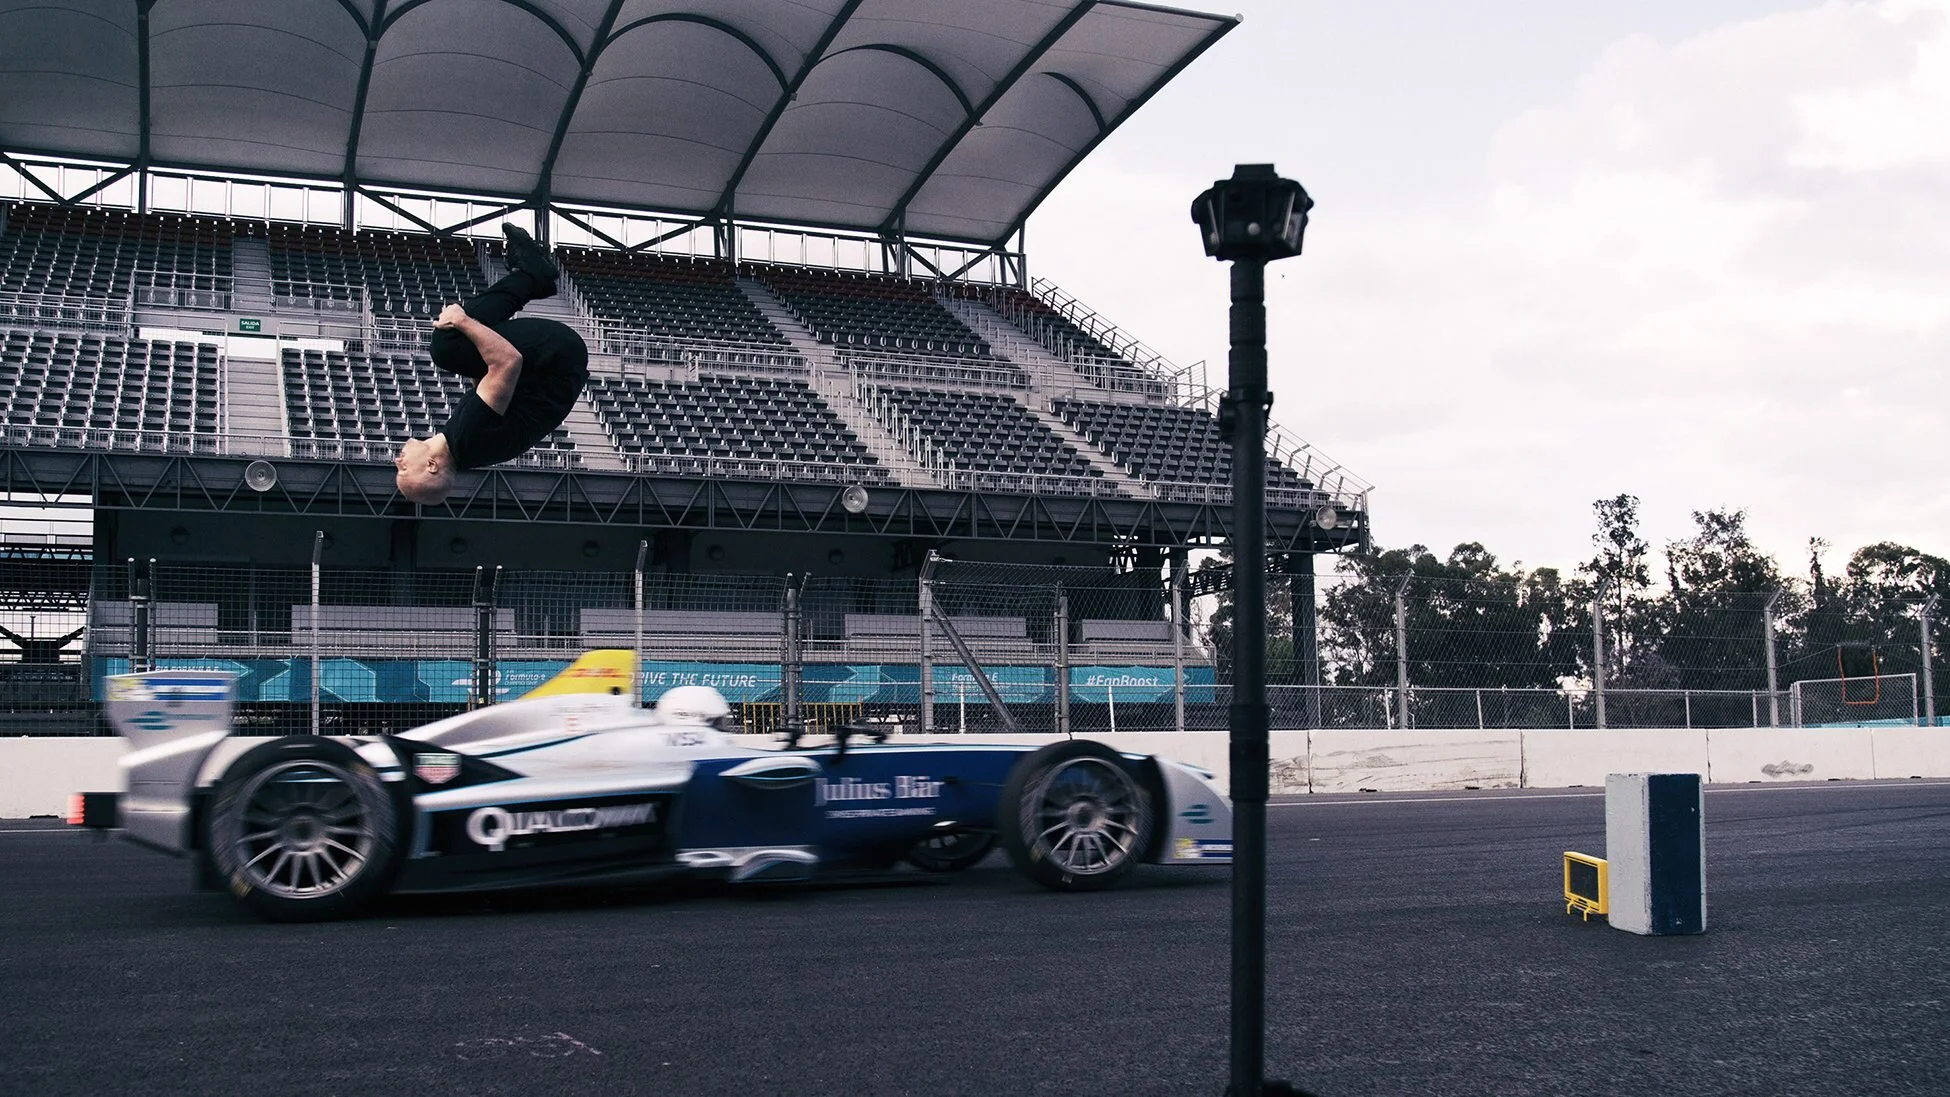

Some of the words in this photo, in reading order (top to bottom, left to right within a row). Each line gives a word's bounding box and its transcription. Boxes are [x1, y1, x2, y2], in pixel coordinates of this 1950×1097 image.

[671, 672, 698, 686] THE
[701, 674, 758, 688] FUTURE
[992, 672, 999, 682] E
[1086, 675, 1159, 687] #FanBoost
[814, 777, 893, 807] Julius
